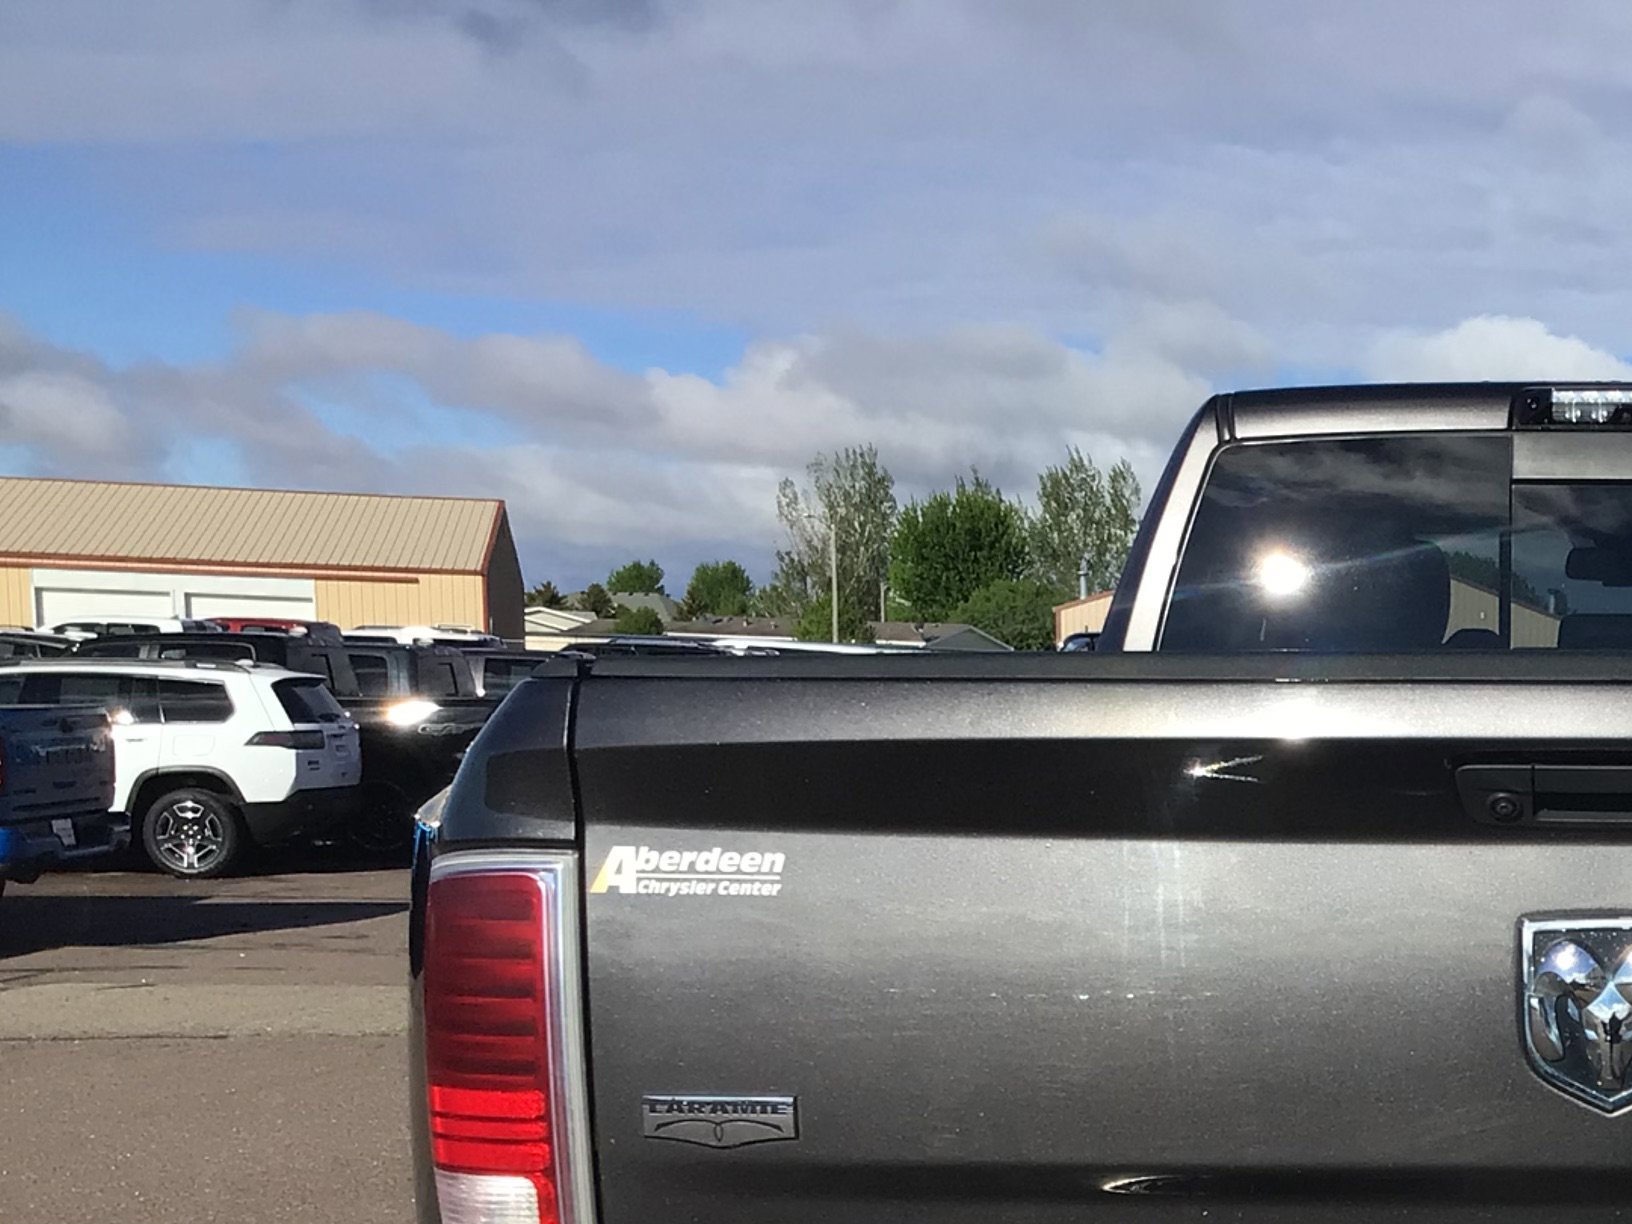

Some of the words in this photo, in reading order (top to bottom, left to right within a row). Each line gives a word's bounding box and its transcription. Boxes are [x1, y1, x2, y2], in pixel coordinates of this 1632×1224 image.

[590, 845, 786, 894] Aberdeen
[637, 879, 715, 897] Chrysler
[717, 880, 782, 896] Center
